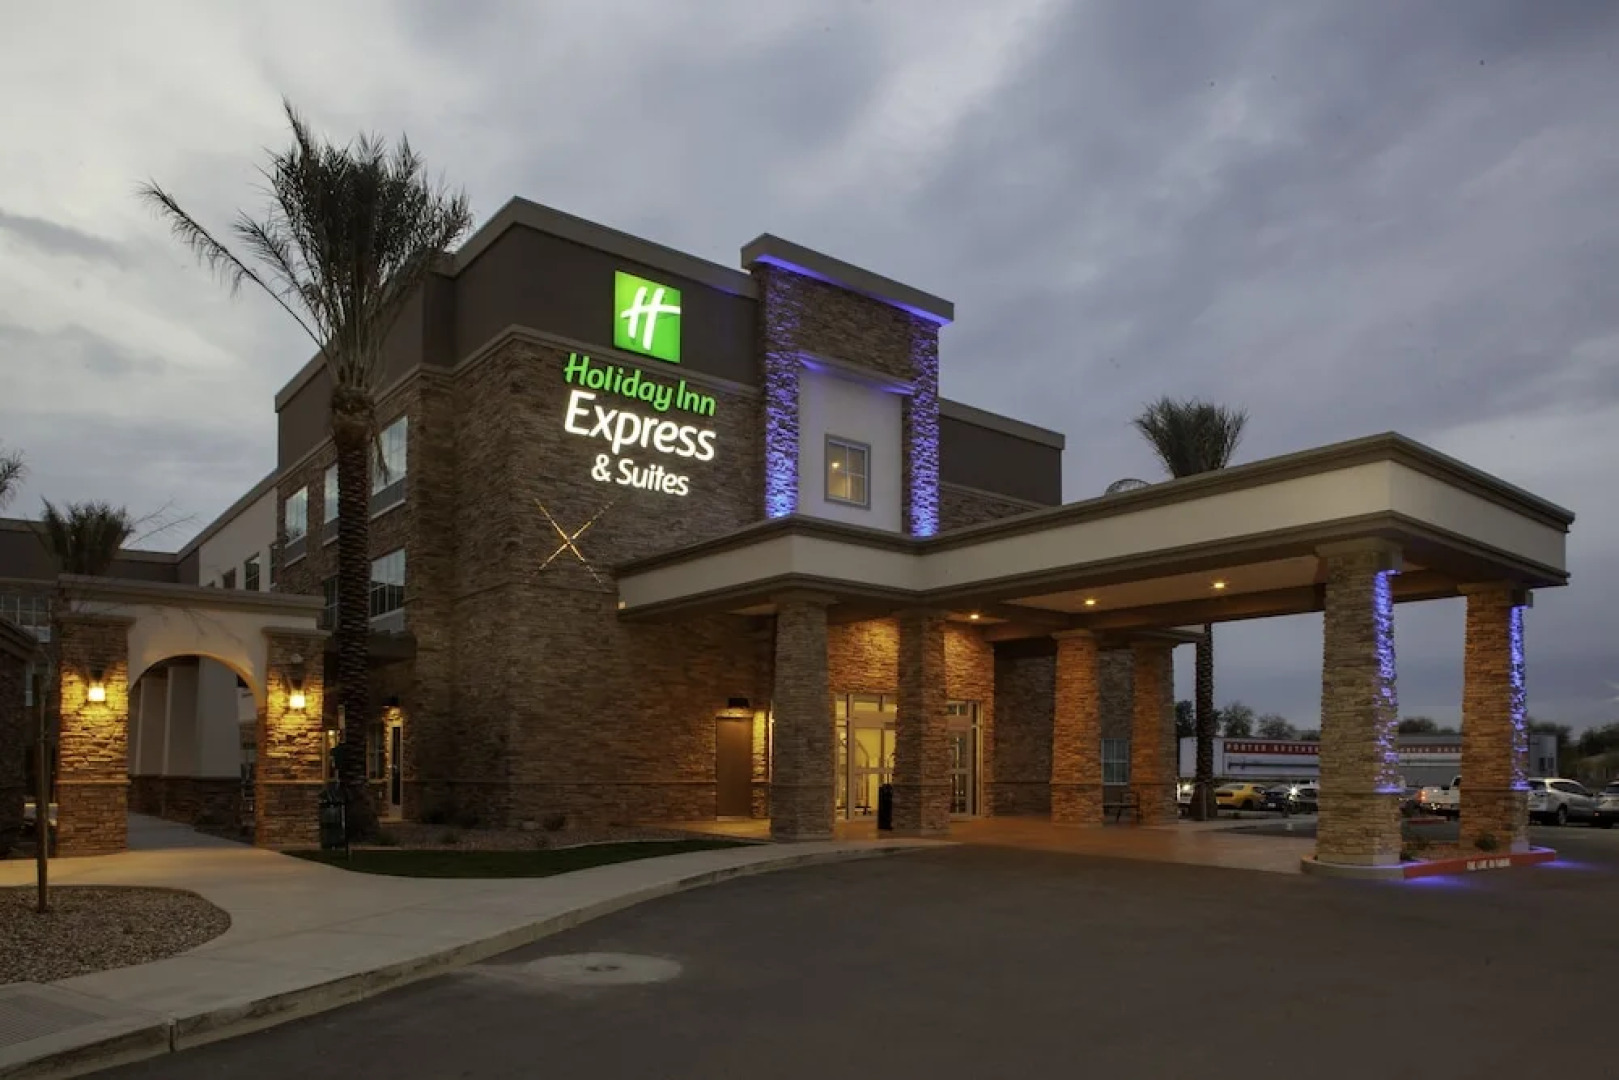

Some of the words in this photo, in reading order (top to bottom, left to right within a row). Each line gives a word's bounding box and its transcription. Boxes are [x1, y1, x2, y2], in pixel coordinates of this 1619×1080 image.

[620, 286, 681, 350] H
[564, 352, 673, 412] Holiday
[677, 380, 716, 416] Inn
[564, 389, 717, 461] Express
[591, 454, 611, 482] &
[616, 459, 689, 496] Suites
